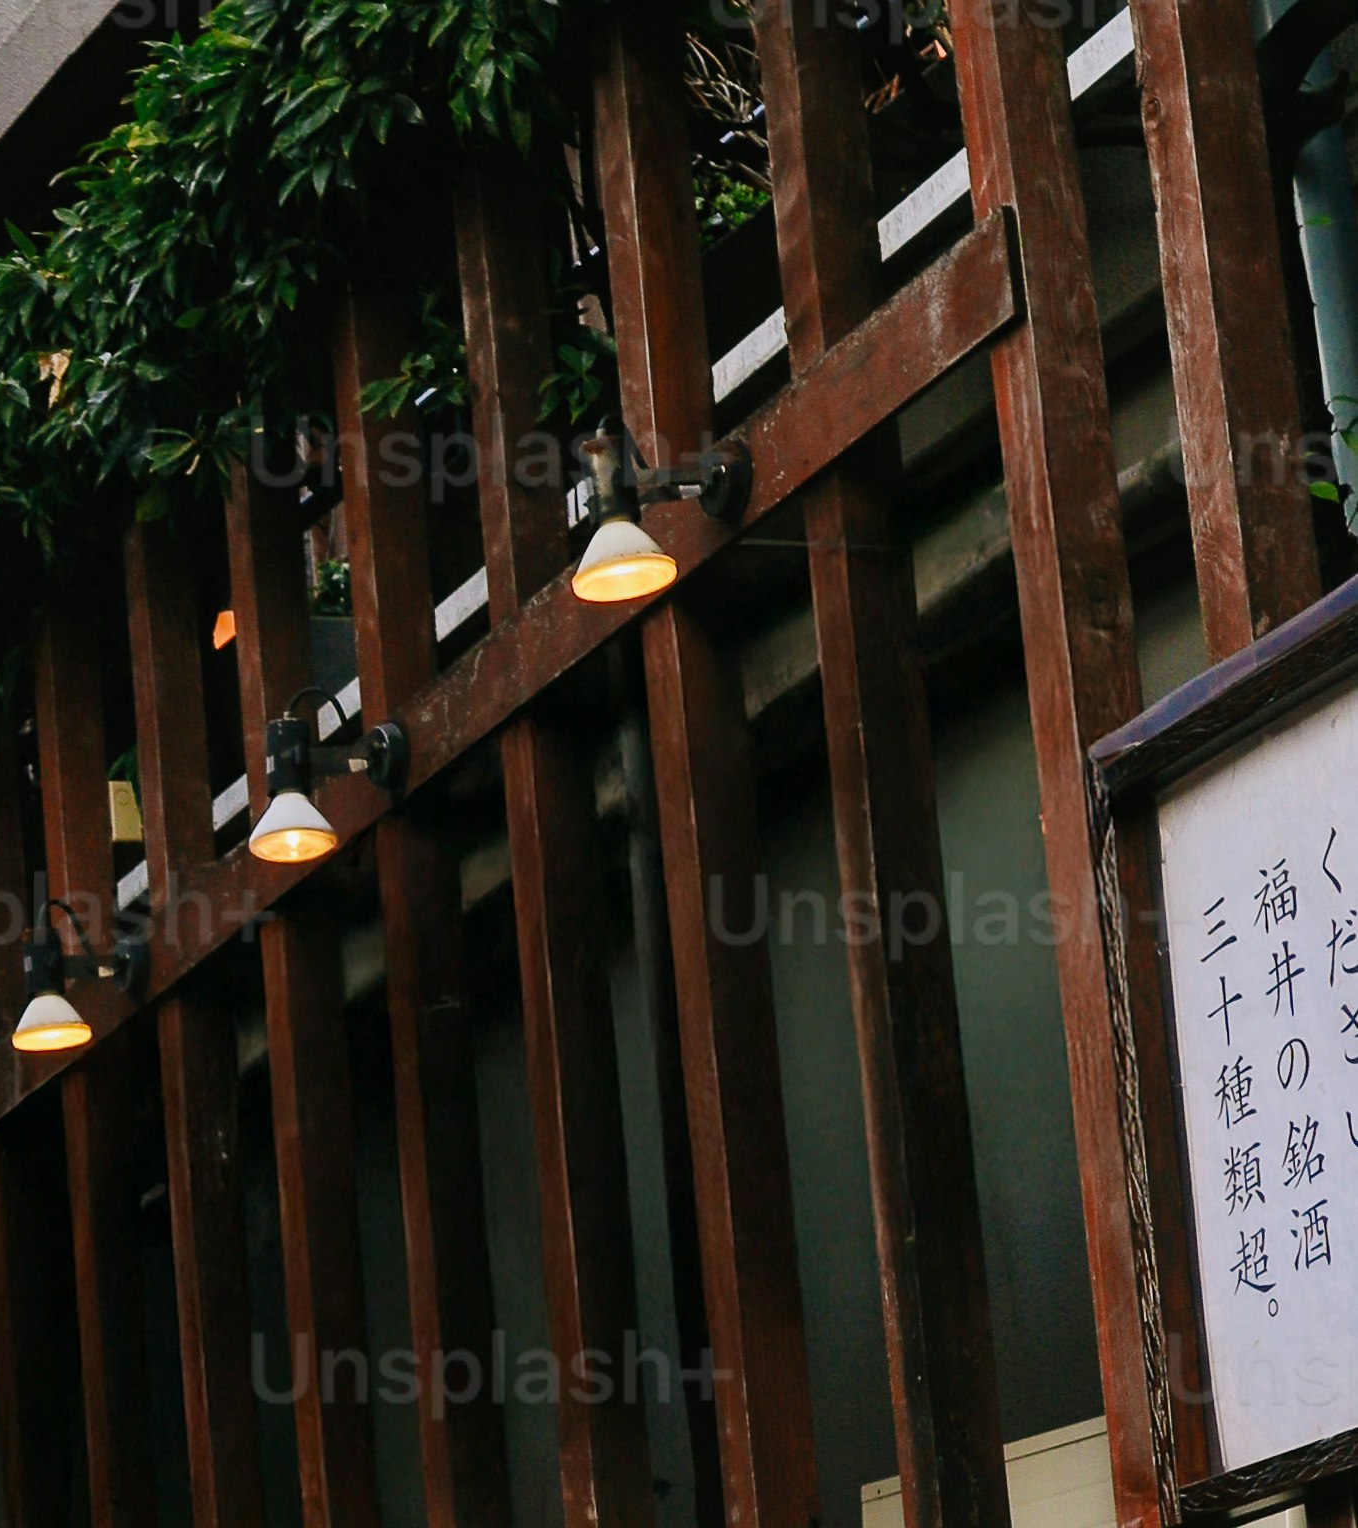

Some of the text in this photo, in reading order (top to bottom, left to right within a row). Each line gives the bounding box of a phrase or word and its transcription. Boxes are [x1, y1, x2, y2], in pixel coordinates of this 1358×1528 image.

[1200, 896, 1279, 1318] 三十種類超。
[1254, 858, 1332, 1271] 福井の銘酒
[1322, 827, 1358, 1148] くだ
